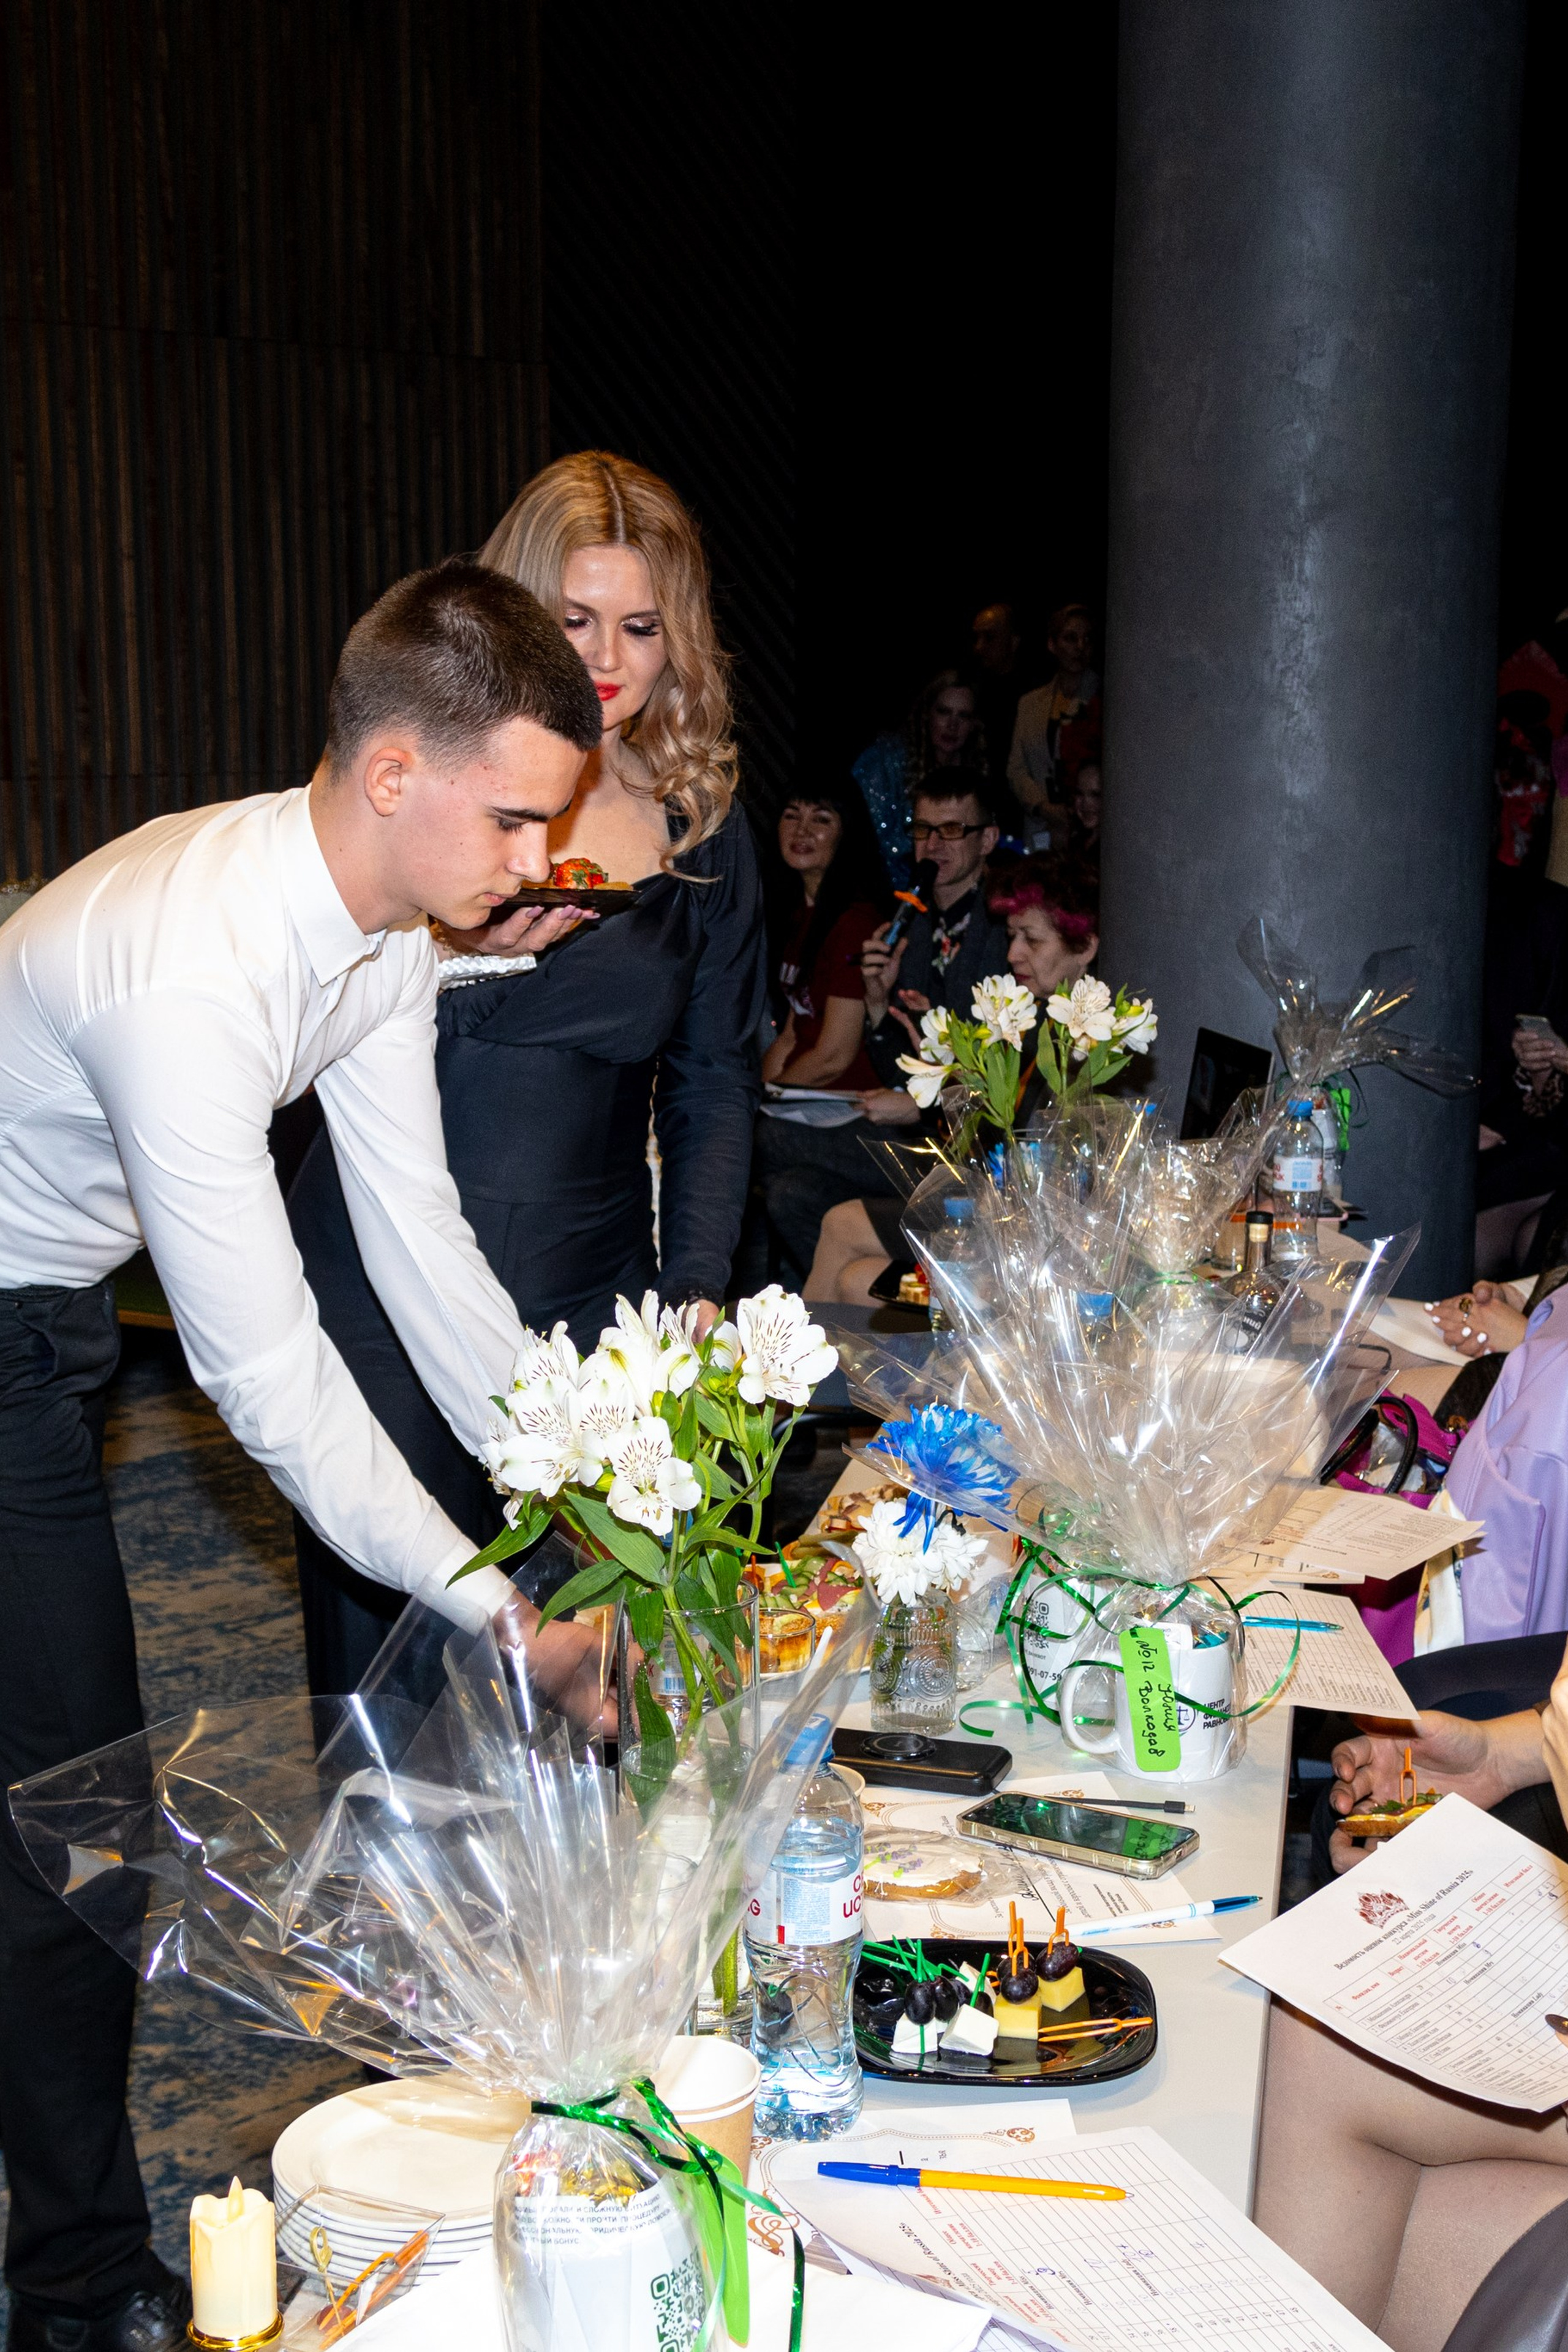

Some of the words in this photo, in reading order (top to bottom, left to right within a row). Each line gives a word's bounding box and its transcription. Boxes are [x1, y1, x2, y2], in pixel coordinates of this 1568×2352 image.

[1028, 1666, 1063, 1681] 91-07-59
[1334, 1950, 1365, 1969] Ведомость
[1362, 1937, 1384, 1952] оценок
[1381, 1920, 1409, 1940] конкурса
[1419, 1897, 1437, 1910] Shine
[1439, 1880, 1460, 1895] Russia
